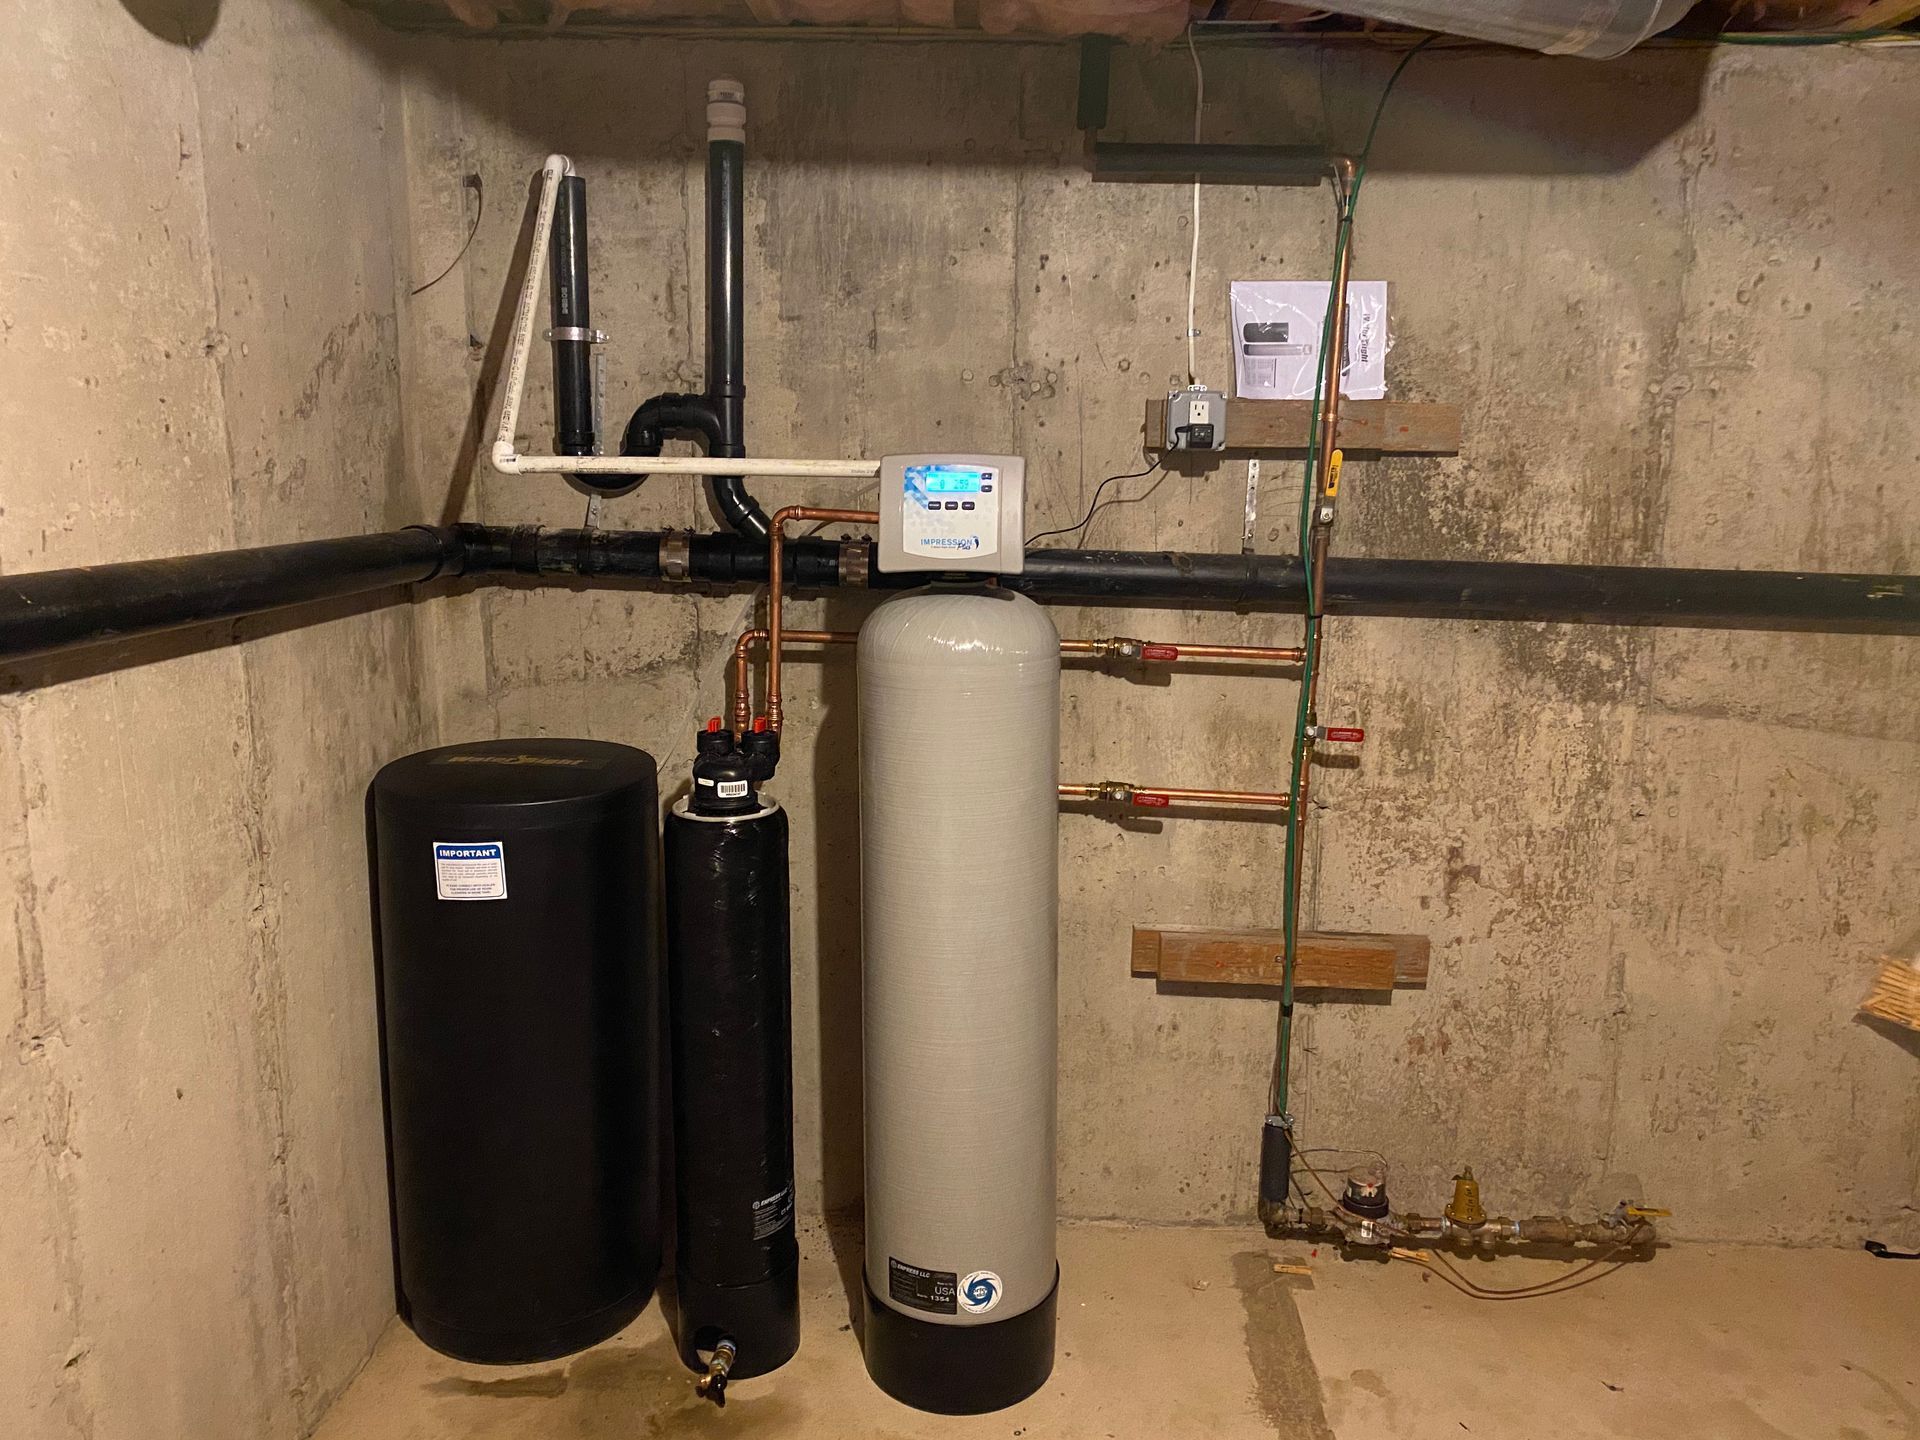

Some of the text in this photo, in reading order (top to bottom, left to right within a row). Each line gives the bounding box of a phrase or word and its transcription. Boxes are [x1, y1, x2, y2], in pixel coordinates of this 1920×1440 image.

[920, 538, 972, 546] IMPRESSION
[440, 848, 497, 857] IMPORTANT
[934, 1286, 956, 1296] USA
[930, 1295, 950, 1303] 1354
